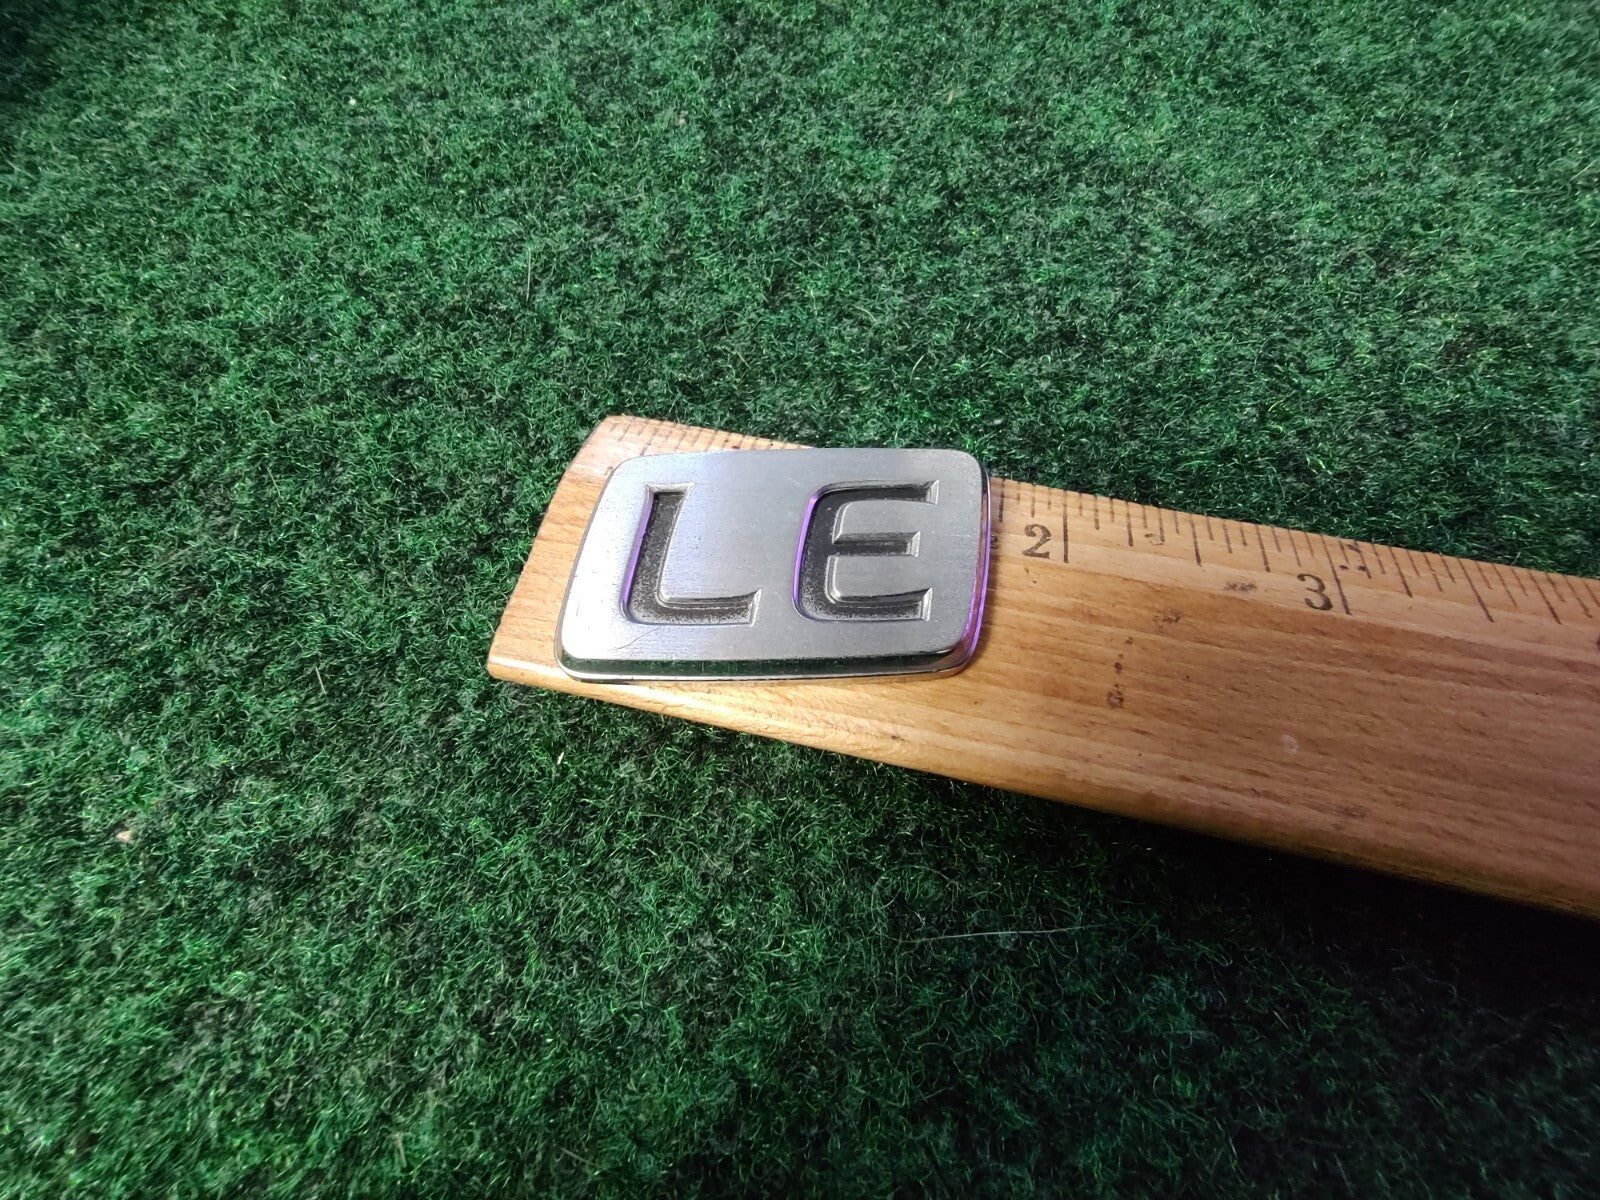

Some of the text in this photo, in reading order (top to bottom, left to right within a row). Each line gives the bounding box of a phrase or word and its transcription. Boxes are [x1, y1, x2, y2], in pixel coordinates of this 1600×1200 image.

[621, 481, 940, 625] LE
[1022, 523, 1334, 611] 2 3
